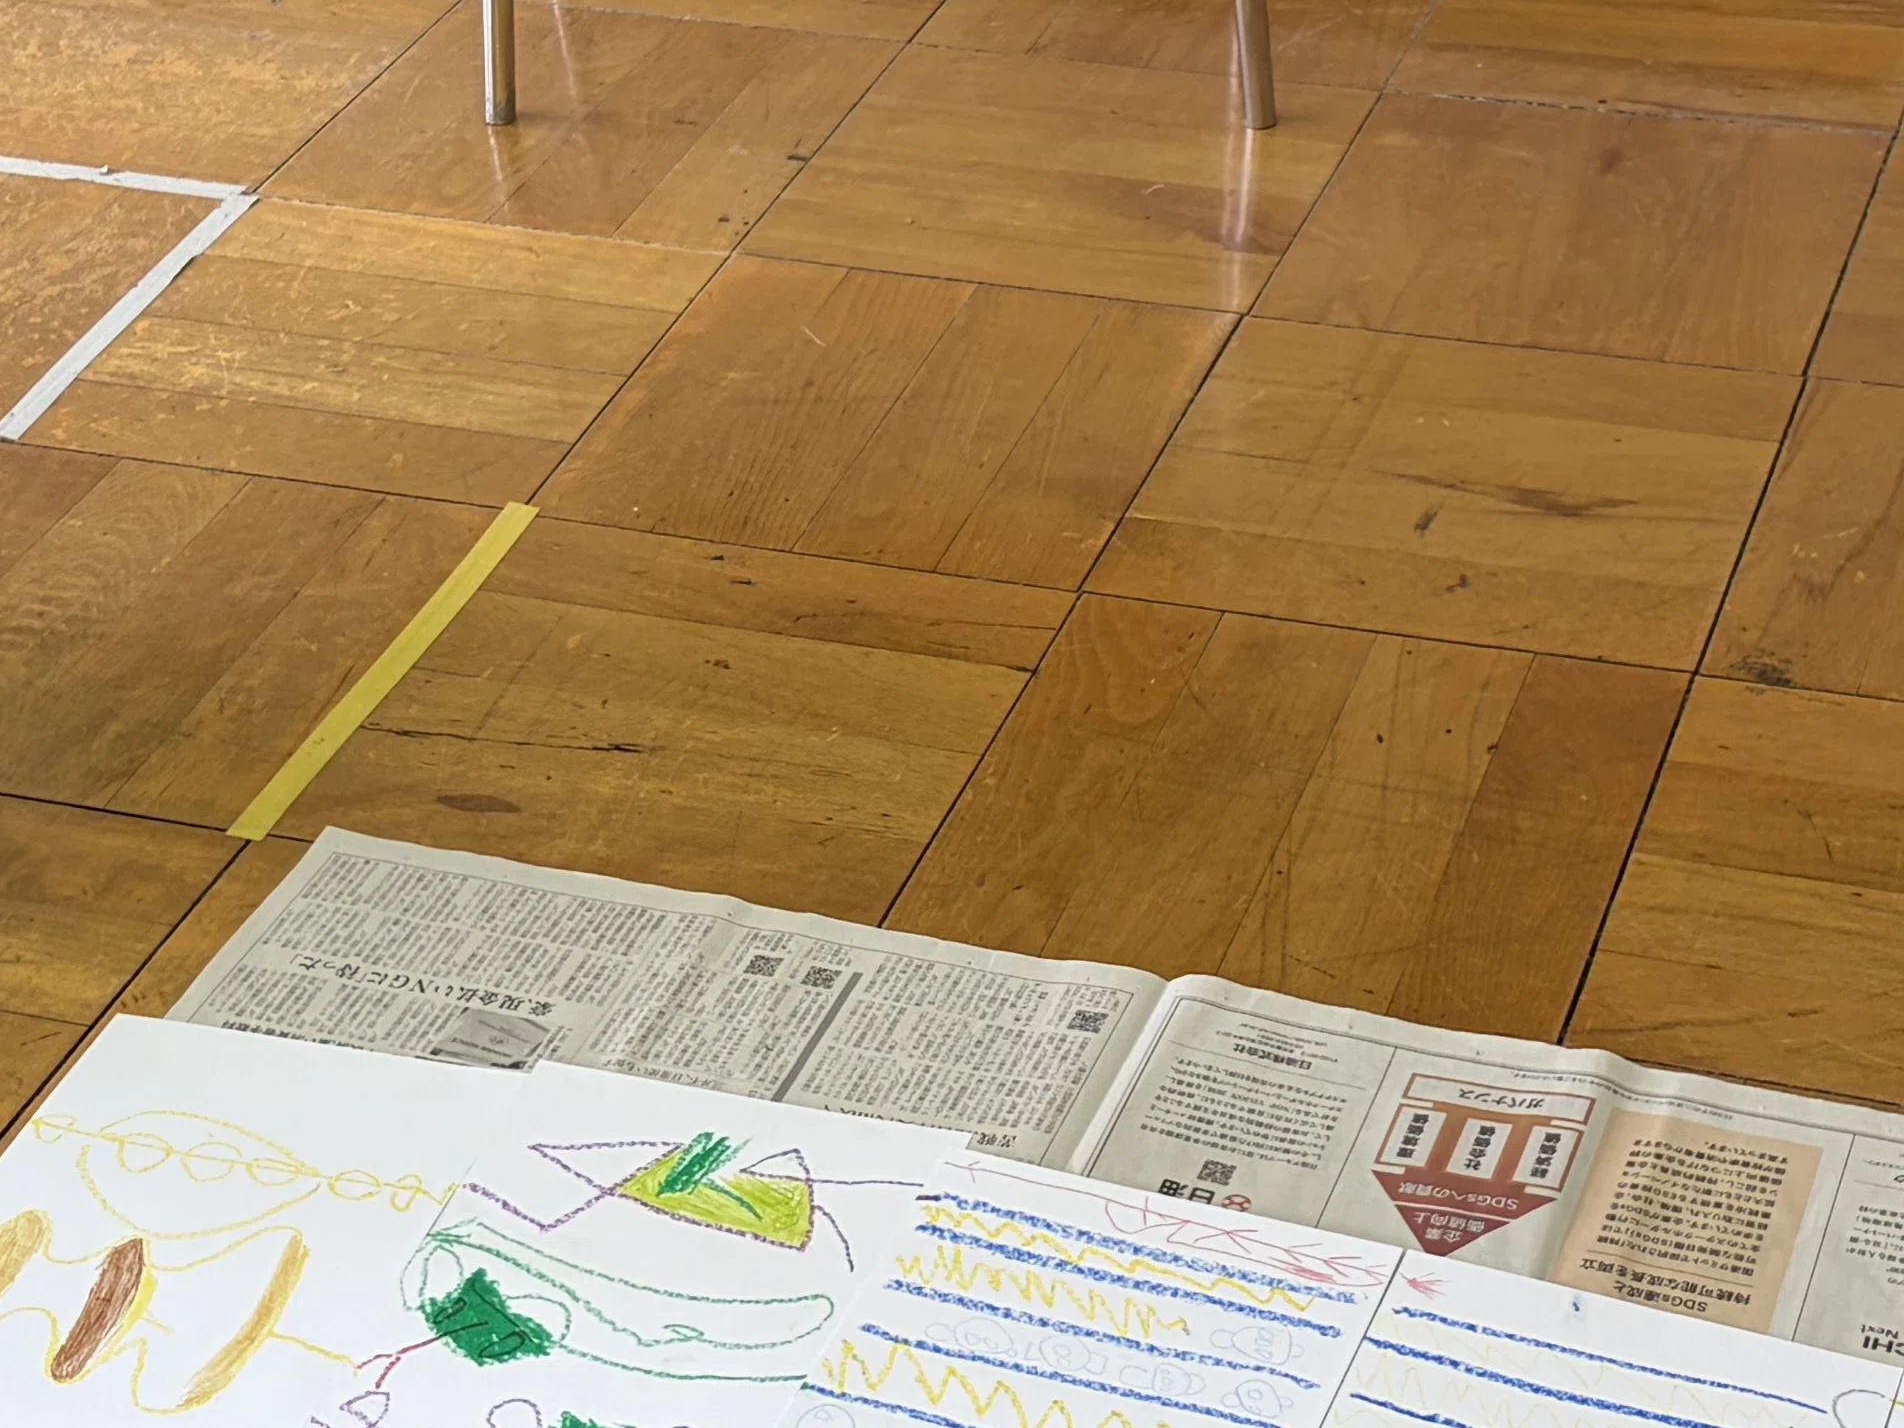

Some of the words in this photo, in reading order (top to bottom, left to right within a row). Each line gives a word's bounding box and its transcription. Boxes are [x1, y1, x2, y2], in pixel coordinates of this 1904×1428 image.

[1455, 1081, 1546, 1114] ガバナンス
[1394, 1111, 1431, 1160] 環境価値
[1461, 1123, 1498, 1172] 社会価値
[1528, 1130, 1563, 1179] 経済価値
[1395, 1173, 1521, 1217] SDGsへの貢献
[1408, 1205, 1486, 1237] 価値向上
[1421, 1223, 1463, 1245] 企業
[1577, 1254, 1752, 1307] 持続可能な成長を両立
[1609, 1279, 1709, 1314] SDGs達成と
[1857, 1322, 1900, 1341] Next
